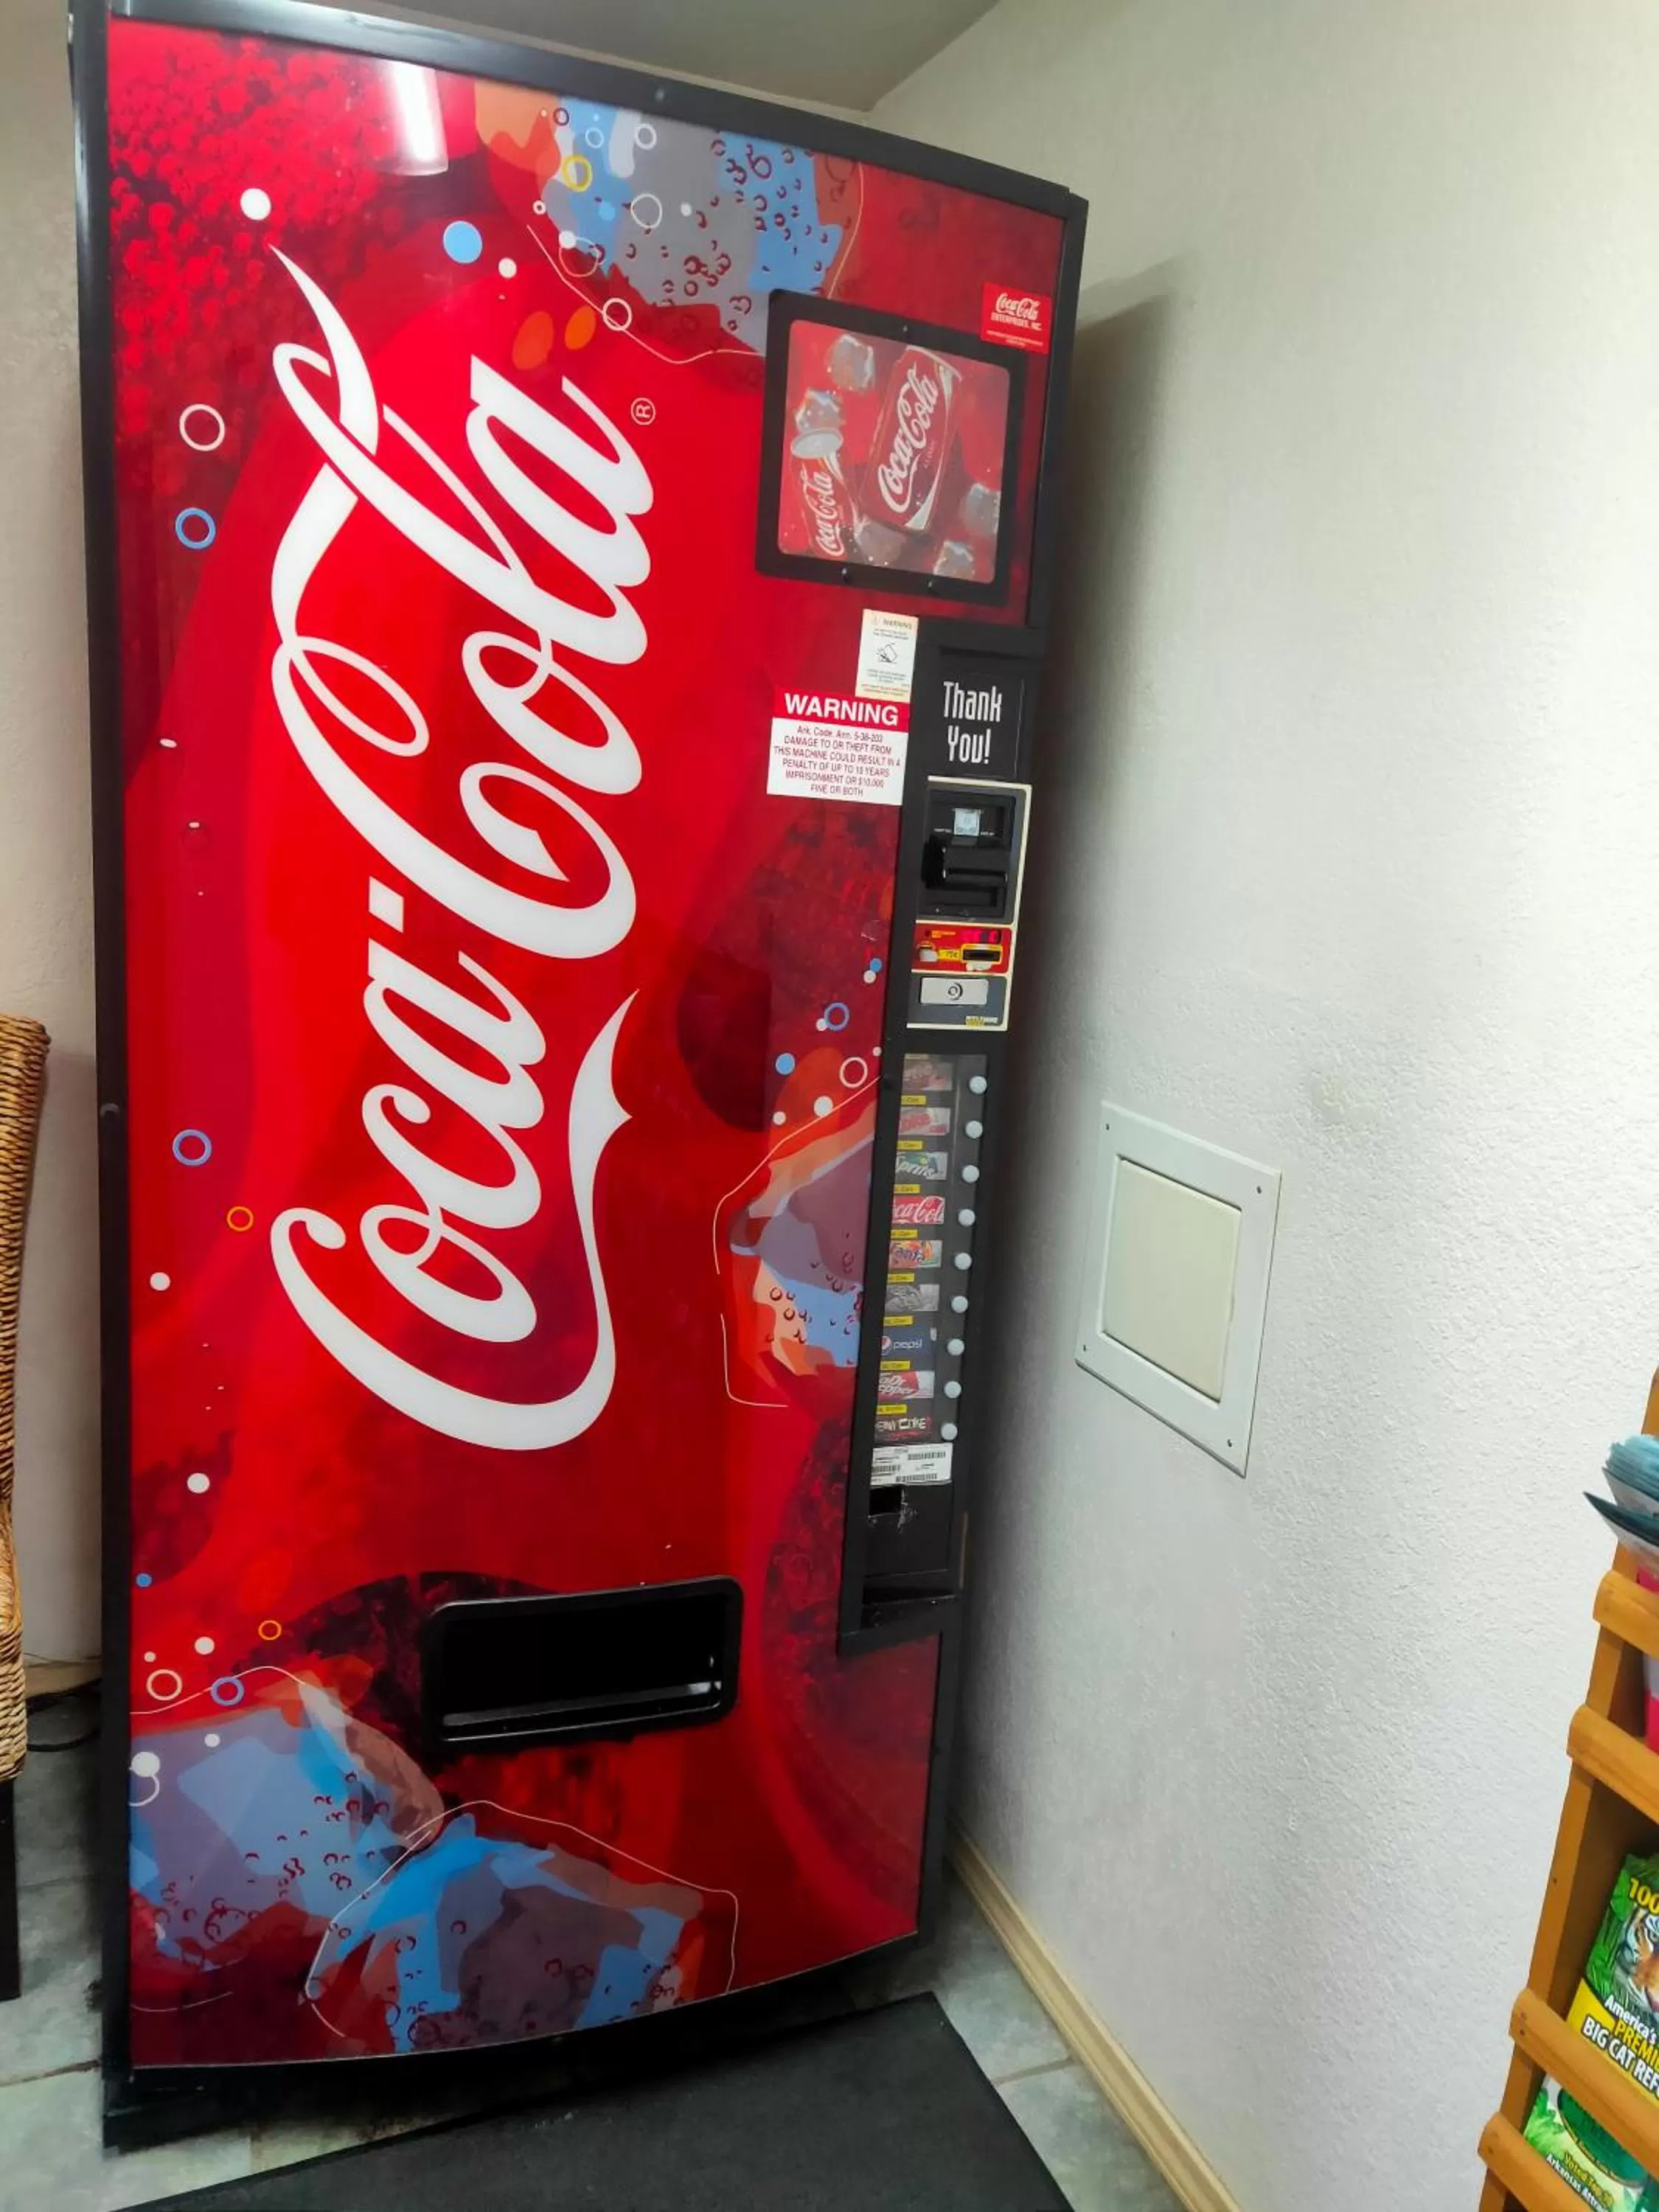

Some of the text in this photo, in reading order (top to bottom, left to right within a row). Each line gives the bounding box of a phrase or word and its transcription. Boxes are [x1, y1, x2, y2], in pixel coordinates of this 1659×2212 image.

[995, 293, 1040, 321] Coca-Cola
[877, 360, 938, 513] Coca-Cola
[800, 462, 844, 556] Coca-Cola
[785, 692, 899, 726] WARNING
[943, 681, 1002, 722] Thank
[773, 745, 790, 755] THIS
[793, 748, 827, 760] MACHINE
[830, 751, 855, 762] COULD
[858, 754, 885, 765] RESULT
[784, 736, 891, 754] DAMAGE TO OR THEFT FROM
[947, 725, 992, 765] You!
[782, 758, 817, 770] PENALTY
[819, 762, 830, 771] OF
[831, 763, 842, 771] UP
[844, 765, 854, 773] TO
[866, 767, 890, 777] YEARS
[785, 769, 844, 784] IMPRISONMENT
[846, 775, 857, 785] OR
[810, 784, 863, 796] FINE OR BOTH
[269, 247, 654, 1451] Coca-Cola
[1604, 1994, 1657, 2045] America's
[1583, 2015, 1659, 2098] BIG CAT REF
[1546, 2153, 1582, 2193] Arkansas
